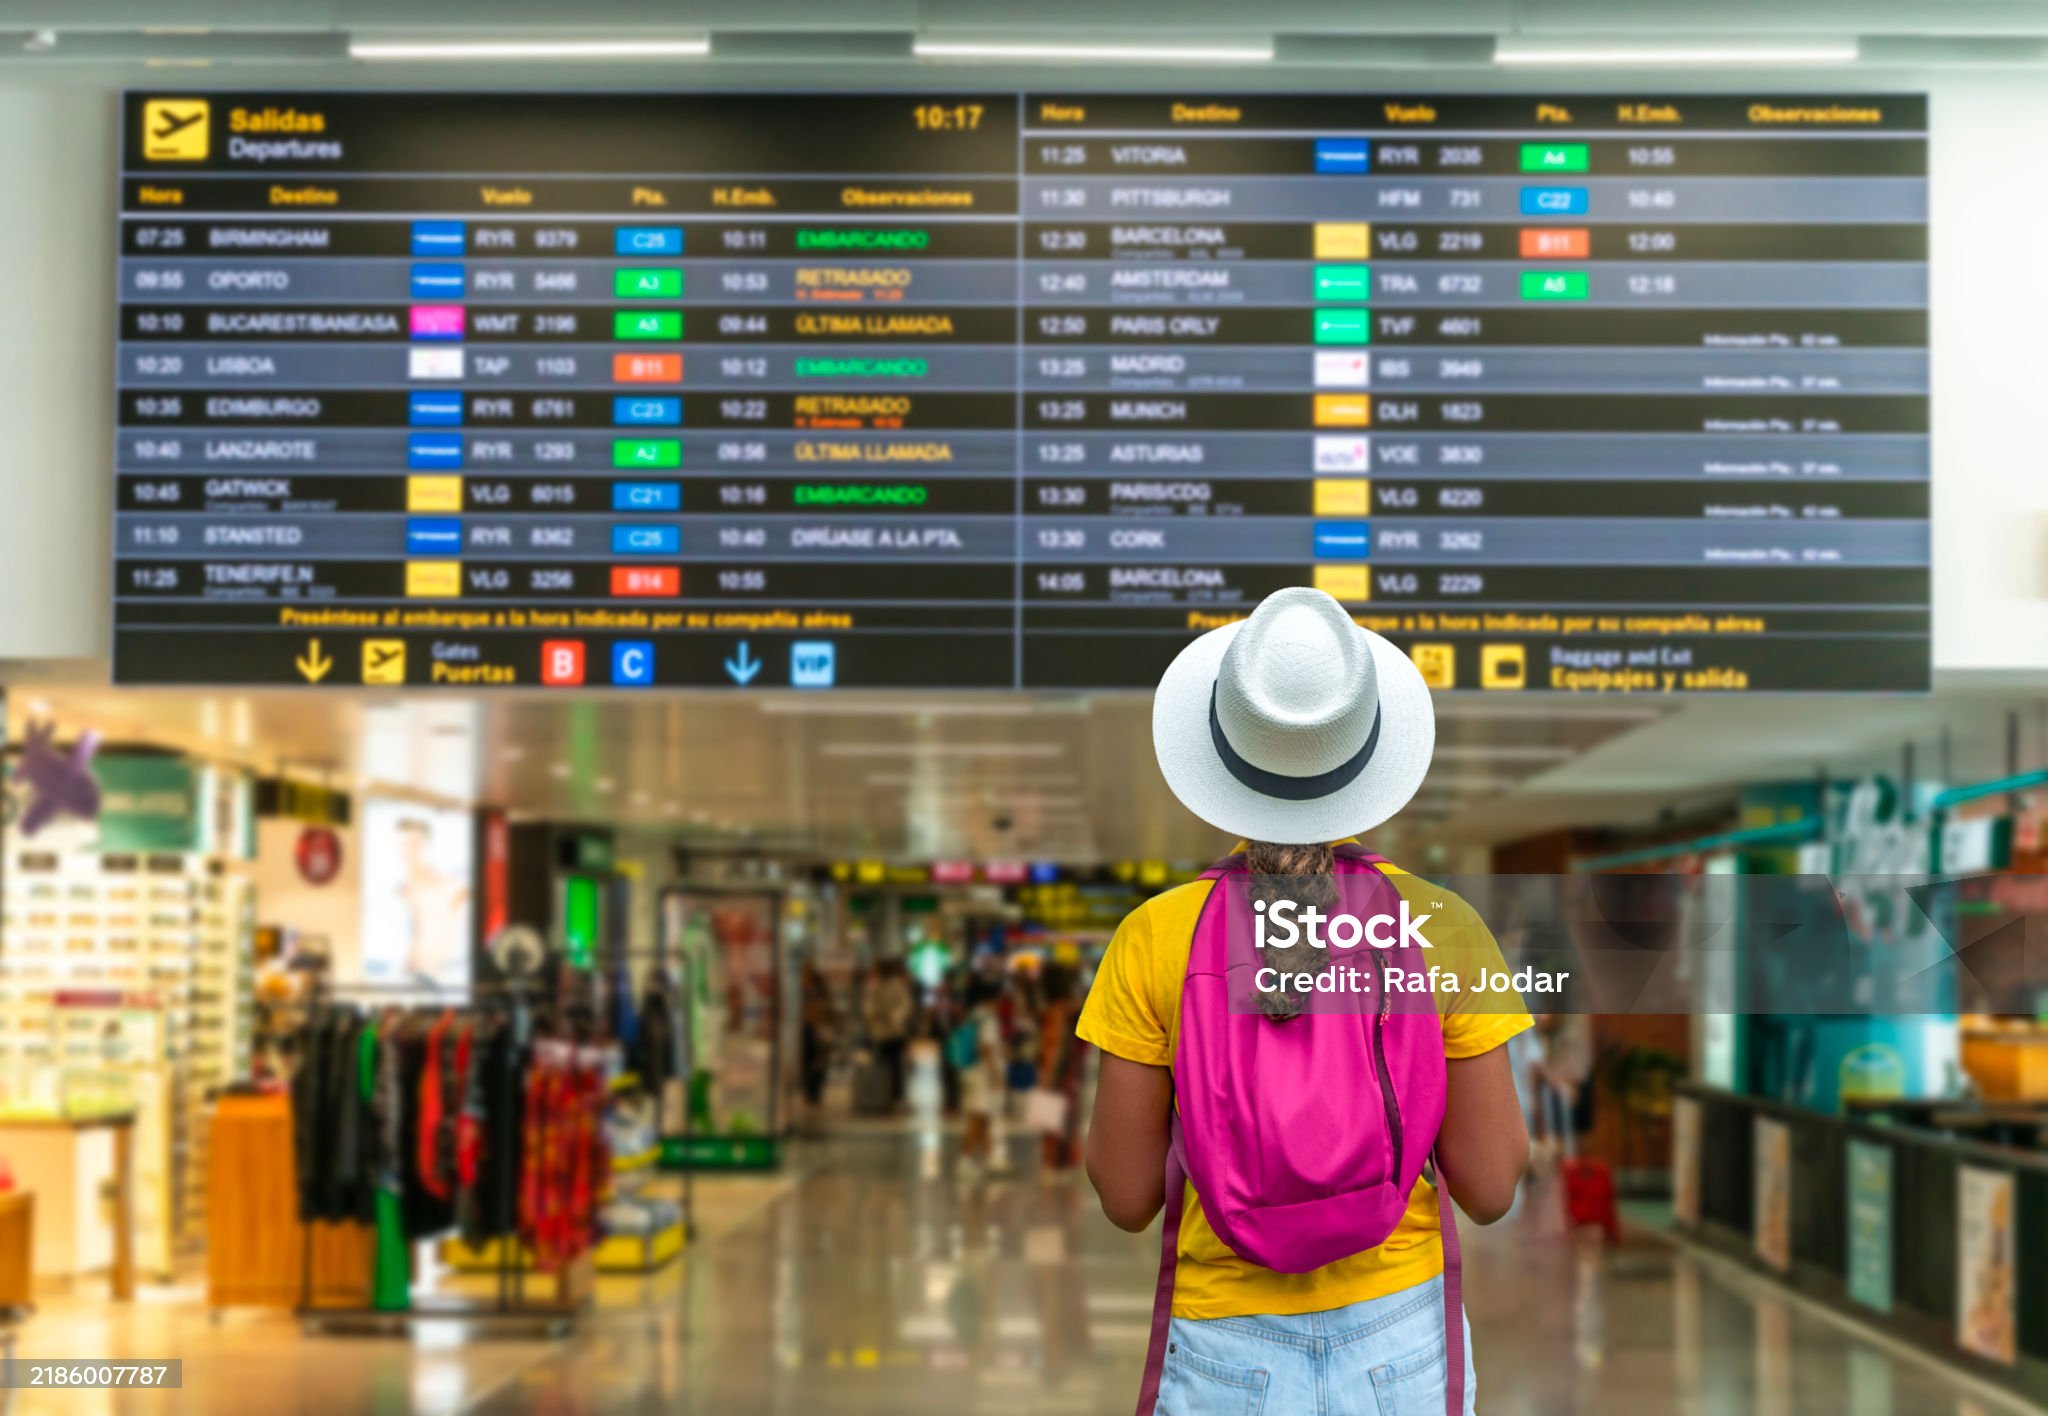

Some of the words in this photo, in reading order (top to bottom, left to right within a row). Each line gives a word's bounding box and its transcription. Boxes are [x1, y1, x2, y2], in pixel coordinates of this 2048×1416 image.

[229, 109, 326, 132] Salidas
[914, 107, 982, 129] 10:17
[1041, 105, 1084, 121] Hora
[1173, 105, 1240, 121] Destino
[1385, 105, 1435, 121] Vuelo
[1537, 106, 1572, 122] Pta.
[1748, 106, 1880, 122] Observaciones
[229, 138, 342, 160] Departures
[1041, 148, 1085, 164] 11:25
[1112, 148, 1186, 164] VITORIA
[1379, 148, 1418, 164] RYR
[141, 187, 183, 204] Hora
[270, 187, 338, 204] Destino
[481, 188, 532, 204] Vuelo
[633, 188, 666, 205] Pta.
[842, 188, 972, 205] Observaciones
[1112, 191, 1229, 207] PITTSBURGH
[137, 229, 184, 246] 07:25
[210, 231, 328, 247] BIRMINGHAM
[475, 231, 514, 247] RYR
[723, 232, 766, 247] 10:11
[797, 232, 929, 248] EMBARCANDO
[1111, 229, 1224, 245] BARCELONA
[1379, 234, 1417, 250] VLG
[209, 273, 288, 289] OPORTO
[475, 273, 514, 289] RYR
[797, 269, 910, 286] RETRASADO
[1041, 275, 1086, 291] 12:40
[1112, 271, 1228, 287] AMSTERDAM
[1379, 276, 1416, 292] TRA
[137, 315, 183, 331] 10:10
[474, 316, 518, 332] WMT
[796, 314, 862, 334] ÚLTIMA
[866, 317, 952, 334] LLAMADA
[1112, 317, 1165, 334] PARIS
[1170, 317, 1218, 334] ORLY
[1379, 319, 1414, 335] TVF
[137, 357, 182, 374] 10:20
[208, 358, 275, 374] LISBOA
[474, 359, 509, 375] TAP
[722, 359, 767, 375] 10:12
[796, 359, 927, 376] EMBARCANDO
[1111, 356, 1184, 373] MADRID
[207, 399, 319, 416] EDIMBURGO
[473, 399, 512, 416] RYR
[722, 402, 766, 418] 10:22
[796, 397, 910, 415] RETRASADO
[1111, 403, 1185, 419] MUNICH
[1379, 404, 1417, 421] DLH
[134, 442, 180, 458] 10:40
[205, 443, 315, 459] LANZAROTE
[472, 443, 511, 459] RYR
[795, 442, 862, 461] ÚLTIMA
[865, 445, 952, 461] LLAMADA
[1111, 446, 1203, 462] ASTURIAS
[1379, 446, 1418, 463] VOE
[134, 485, 179, 501] 10:45
[206, 480, 290, 496] GATWICK
[472, 486, 509, 501] VLG
[630, 489, 661, 503] C21
[795, 487, 926, 504] EMBARCANDO
[1111, 484, 1210, 500] PARIS/CDG
[1379, 489, 1417, 506] VLG
[133, 527, 178, 544] 11:10
[205, 527, 302, 545] STANSTED
[471, 528, 510, 545] RYR
[720, 530, 765, 547] 10:40
[792, 528, 873, 547] DIRÍJASE
[878, 530, 893, 547] A
[896, 530, 919, 547] LA
[924, 530, 962, 547] PTA.
[1111, 532, 1164, 548] CORK
[1379, 532, 1418, 549] RYR
[133, 570, 178, 586] 11:25
[470, 571, 508, 587] VLG
[1038, 574, 1084, 590] 14:05
[1110, 570, 1224, 587] BARCELONA
[1379, 575, 1417, 592] VLG
[281, 608, 377, 627] Preséntese
[384, 609, 399, 625] al
[404, 608, 489, 628] embarque
[496, 612, 505, 625] a
[510, 609, 526, 626] la
[530, 609, 569, 626] hora
[574, 610, 647, 628] indicada
[653, 614, 682, 629] por
[688, 615, 708, 628] su
[803, 610, 851, 628] aérea
[1403, 617, 1413, 631] a
[1418, 614, 1434, 631] la
[1439, 614, 1479, 631] hora
[1484, 615, 1558, 631] indicada
[1563, 618, 1593, 633] por
[1597, 619, 1619, 631] su
[1715, 614, 1764, 632] aérea
[433, 643, 479, 661] Gates
[1551, 649, 1621, 667] Baggage
[1628, 648, 1656, 665] and
[1661, 648, 1691, 665] Exit
[432, 662, 514, 683] Puertas
[553, 650, 574, 676] B
[622, 650, 643, 678] C
[796, 655, 829, 671] VIP
[1552, 669, 1655, 690] Equipajes
[1662, 673, 1675, 690] y
[1683, 669, 1748, 688] salida
